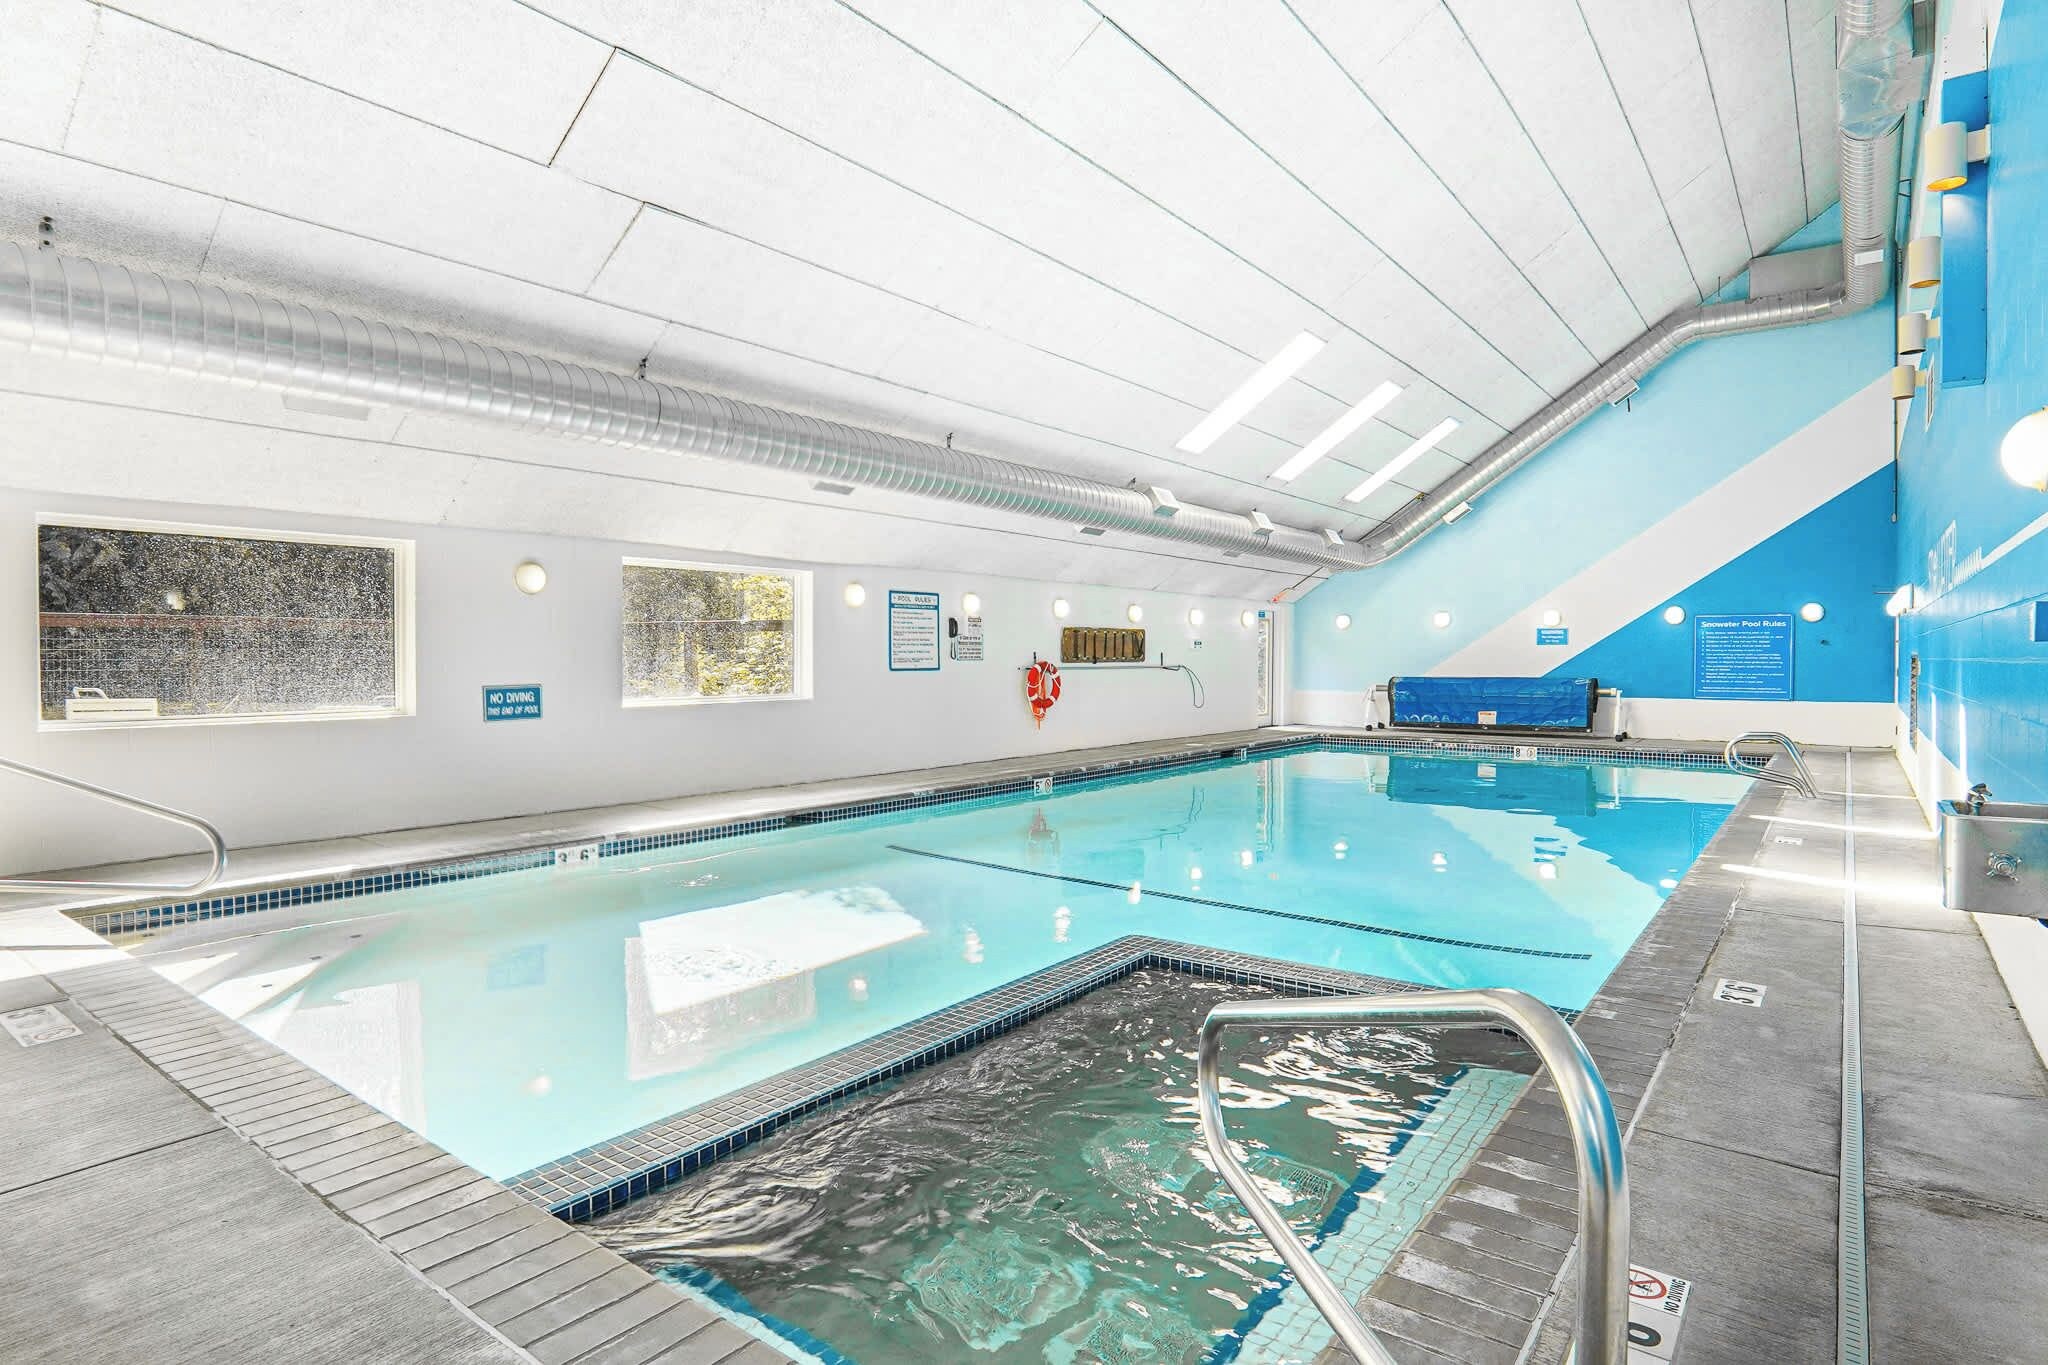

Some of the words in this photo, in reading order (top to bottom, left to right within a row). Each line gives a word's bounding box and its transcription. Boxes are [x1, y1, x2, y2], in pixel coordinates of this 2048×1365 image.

[489, 692, 504, 704] NO
[506, 691, 535, 704] DIVING
[487, 707, 500, 716] THIS
[501, 706, 514, 715] END
[515, 705, 524, 714] OF
[524, 704, 540, 714] POOL
[1668, 1278, 1687, 1303] DIVING
[1663, 1301, 1680, 1314] NO
